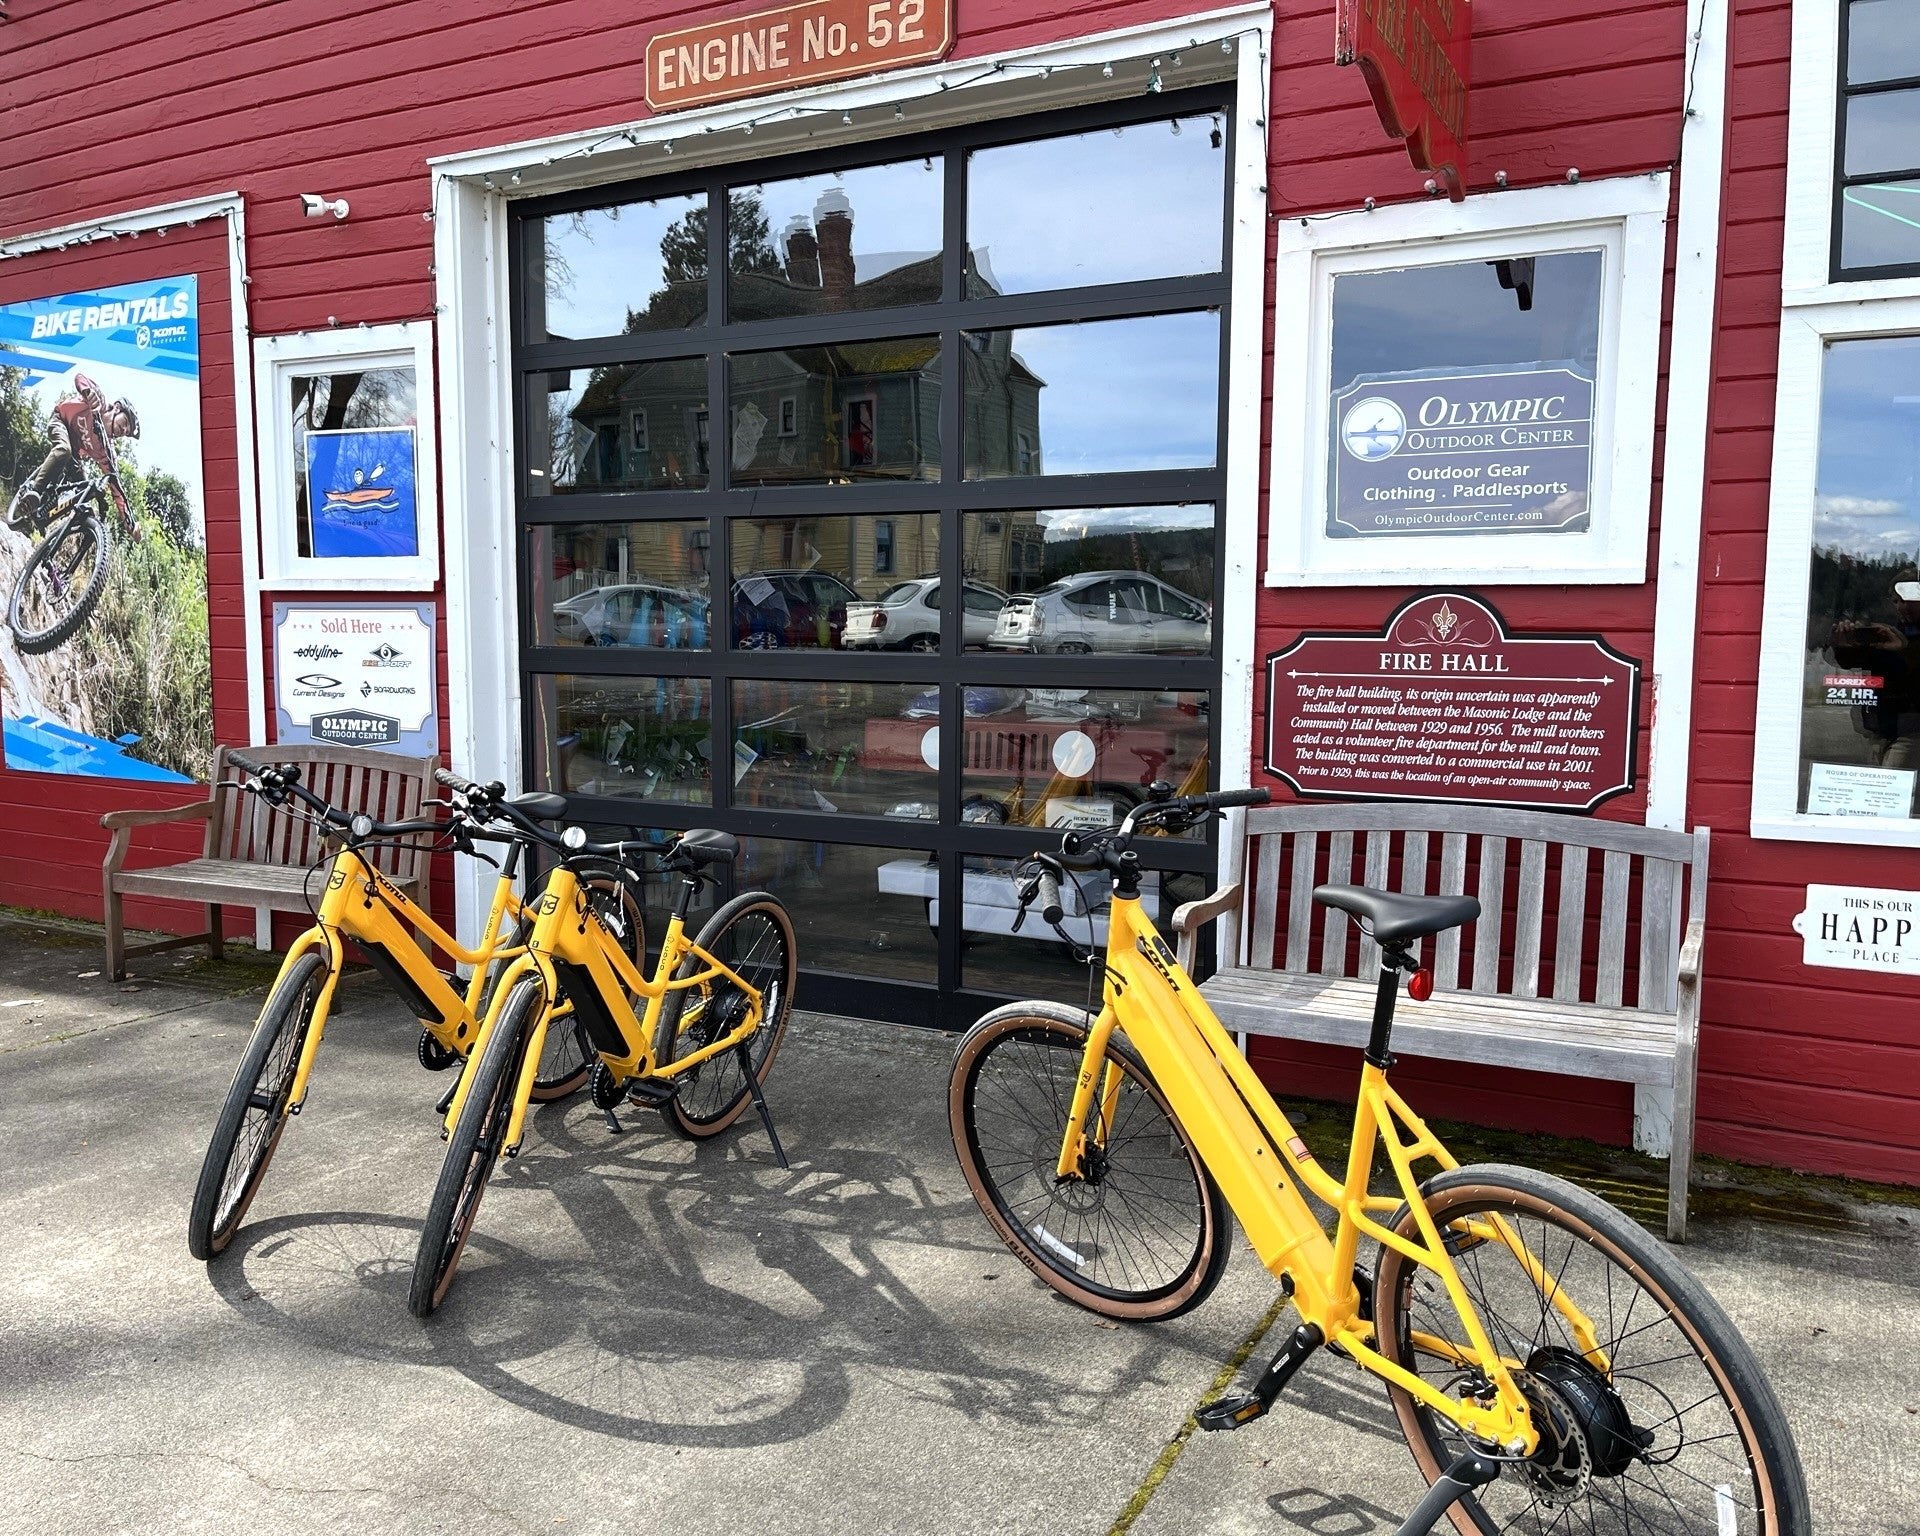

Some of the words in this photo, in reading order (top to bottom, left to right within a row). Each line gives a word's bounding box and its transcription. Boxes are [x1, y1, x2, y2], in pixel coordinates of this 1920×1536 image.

[659, 23, 789, 91] ENGINE
[802, 16, 859, 62] No.
[868, 0, 924, 48] 52
[31, 309, 82, 339] BIKE
[83, 292, 189, 331] RENTALS
[1419, 396, 1565, 426] OLYMPIC
[1408, 433, 1494, 449] OUTDOOR
[1501, 427, 1574, 445] CENTER
[1408, 466, 1481, 480] Outdoor
[1488, 464, 1529, 477] Gear
[1364, 487, 1435, 502] Clothing
[1453, 481, 1568, 498] Paddlesports
[1375, 511, 1542, 526] OlympicOutdoorCenter.com
[321, 618, 347, 633] Sold
[351, 620, 381, 633] Here
[297, 644, 338, 661] eddyline
[1380, 653, 1432, 670] FIRE
[1441, 654, 1509, 672] HALL
[293, 689, 316, 697] Current
[318, 690, 345, 699] Designs
[1297, 685, 1314, 698] The
[1313, 686, 1334, 700] fire
[1336, 686, 1356, 698] hall
[1358, 688, 1402, 702] building,
[1406, 689, 1418, 700] its
[1421, 689, 1453, 703] origin
[1456, 691, 1509, 702] uncertain
[1512, 692, 1535, 703] was
[1537, 692, 1600, 708] apparently
[1827, 688, 1847, 698] 24
[1851, 689, 1877, 699] HR.
[1303, 701, 1346, 713] installed
[1348, 705, 1359, 714] or
[1361, 703, 1396, 715] moved
[1398, 705, 1441, 717] between
[1444, 705, 1460, 717] the
[1463, 706, 1510, 719] Masonic
[1512, 708, 1545, 723] Lodge
[1548, 708, 1572, 721] and
[1574, 709, 1592, 721] the
[322, 718, 388, 731] OLYMPIC
[322, 730, 356, 738] OUTDOOR
[1291, 717, 1349, 732] Community
[1350, 719, 1373, 730] Hall
[1375, 719, 1417, 732] between
[1421, 722, 1447, 734] 1929
[1449, 723, 1472, 734] and
[1474, 723, 1504, 736] 1956.
[1511, 724, 1531, 736] The
[1533, 725, 1557, 737] mill
[1559, 726, 1605, 739] workers
[1293, 733, 1321, 744] acted
[1322, 736, 1334, 744] as
[1336, 736, 1343, 745] a
[1346, 735, 1394, 748] volunteer
[1393, 736, 1414, 750] fire
[1416, 737, 1482, 752] department
[1478, 739, 1498, 754] for
[1499, 741, 1517, 753] the
[1519, 741, 1543, 754] mill
[1544, 742, 1569, 755] and
[1569, 745, 1601, 756] town.
[1295, 748, 1313, 759] The
[1315, 748, 1357, 764] building
[1359, 753, 1379, 762] was
[1382, 754, 1434, 766] converted
[1436, 755, 1446, 766] to
[1448, 758, 1456, 766] a
[1458, 757, 1525, 769] commercial
[1526, 761, 1545, 770] use
[1548, 760, 1560, 771] in
[1562, 760, 1594, 772] 2001.
[1298, 766, 1319, 775] Prior
[1321, 767, 1329, 776] to
[1330, 767, 1352, 778] 1929,
[1355, 768, 1370, 778] this
[1372, 771, 1389, 779] was
[1391, 769, 1404, 780] the
[1406, 771, 1441, 782] location
[1443, 774, 1454, 785] of
[1453, 775, 1465, 783] an
[1468, 774, 1507, 786] open-air
[1508, 776, 1561, 790] community
[1562, 781, 1591, 791] space.
[1843, 898, 1869, 909] THIS
[1874, 901, 1883, 910] IS
[1888, 901, 1912, 912] OUR
[1853, 949, 1899, 963] PLACE
